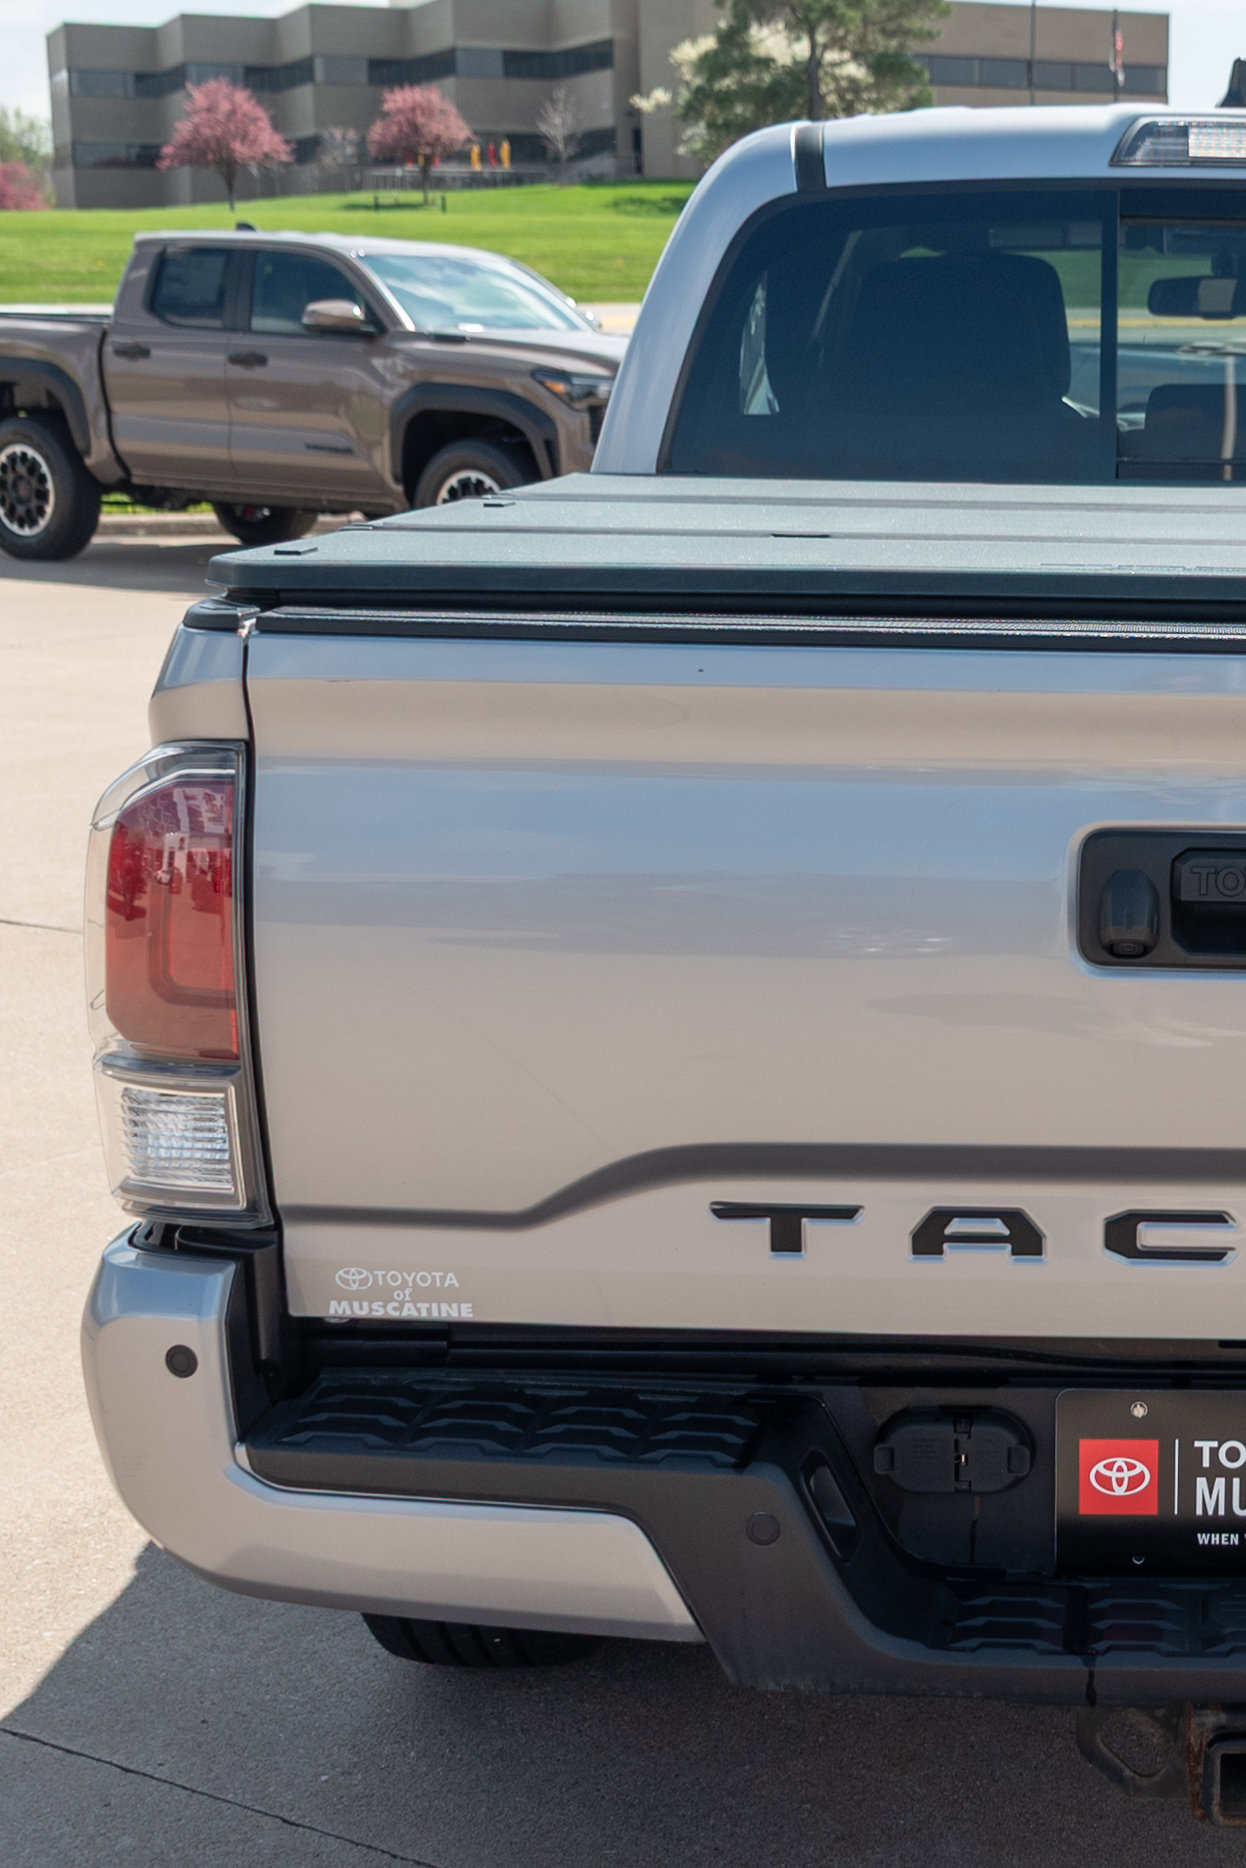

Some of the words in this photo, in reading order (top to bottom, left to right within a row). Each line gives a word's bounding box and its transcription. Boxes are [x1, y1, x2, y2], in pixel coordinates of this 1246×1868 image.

[373, 1270, 460, 1288] TOYOTA
[393, 1288, 413, 1302] of
[328, 1300, 474, 1318] MUSCATINE
[1197, 1532, 1239, 1546] WHEN
